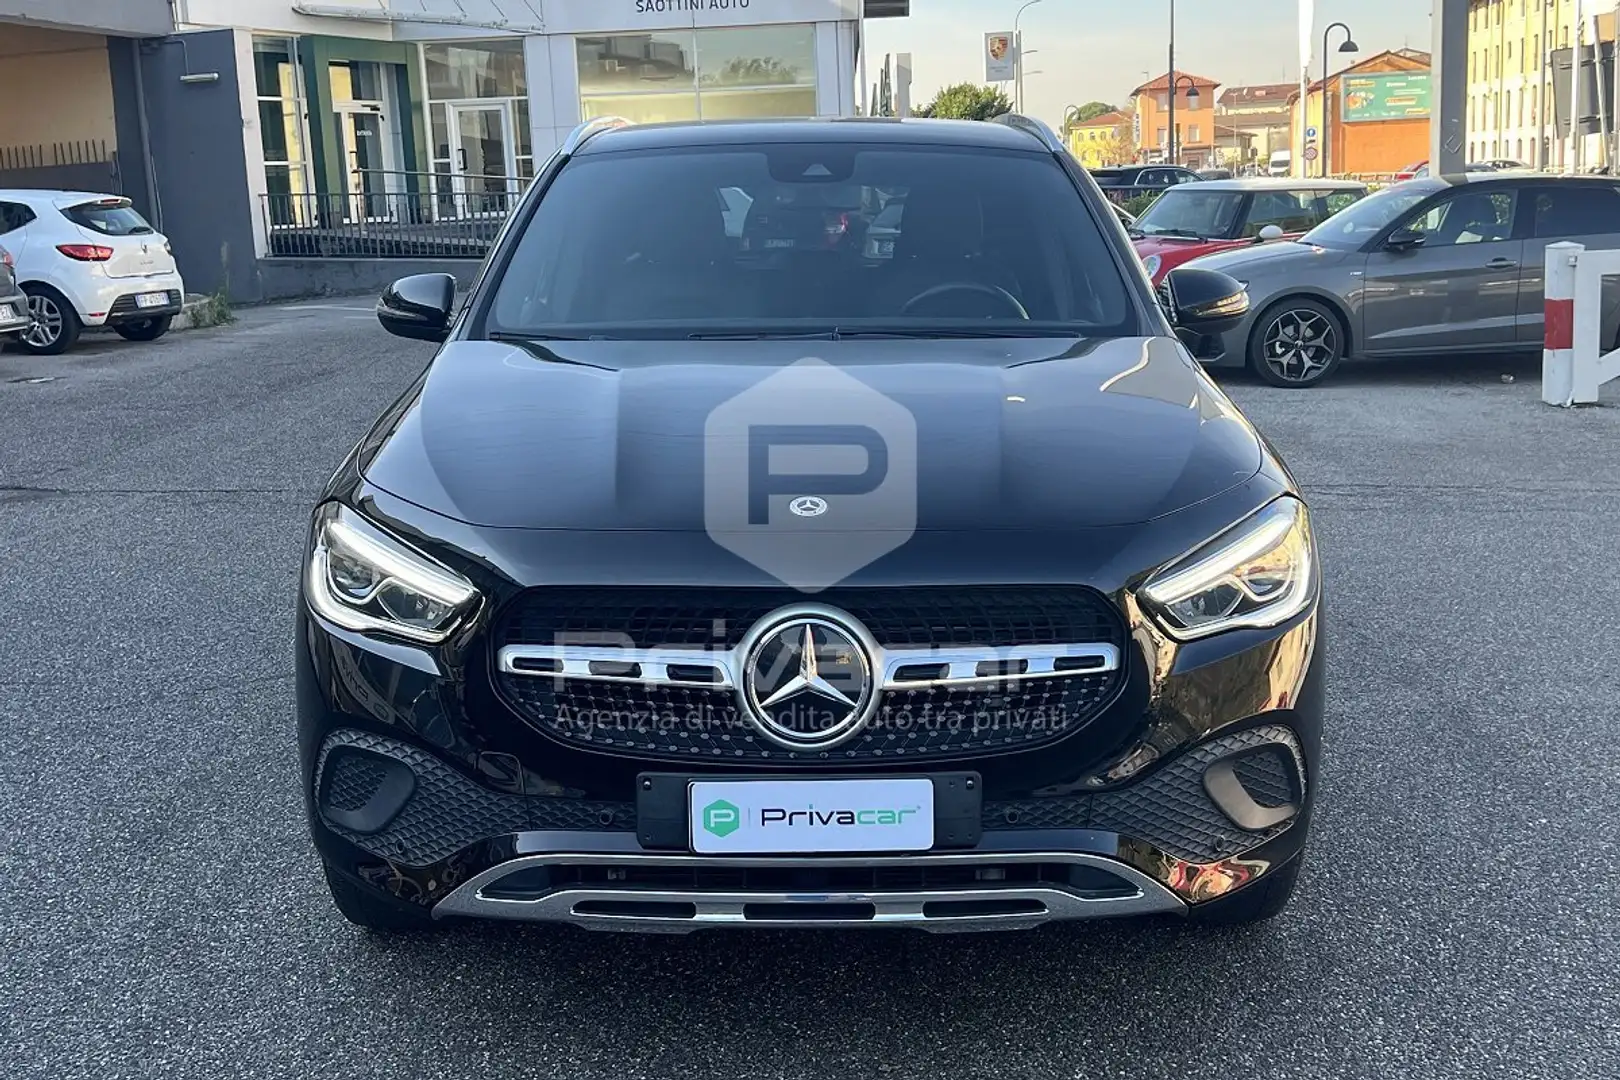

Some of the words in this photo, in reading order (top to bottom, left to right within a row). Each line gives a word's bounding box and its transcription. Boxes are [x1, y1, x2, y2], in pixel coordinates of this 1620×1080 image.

[635, 0, 704, 13] SAOTTINI
[709, 0, 750, 9] AUTO
[709, 809, 735, 827] P
